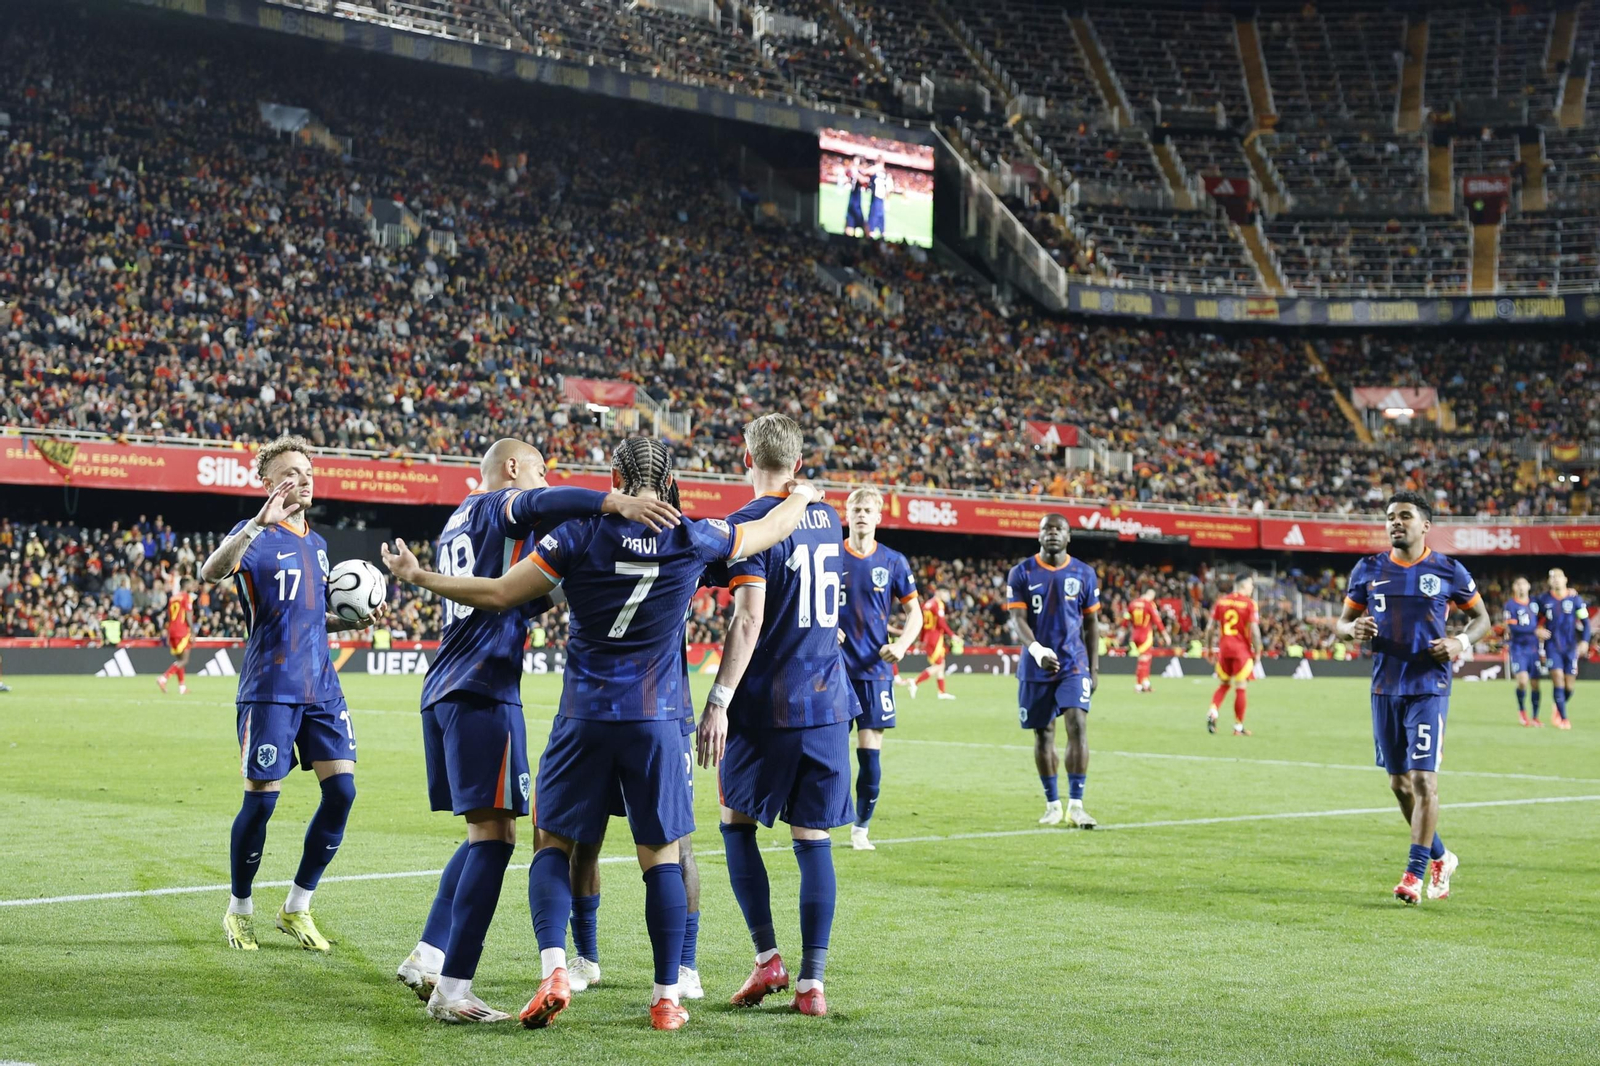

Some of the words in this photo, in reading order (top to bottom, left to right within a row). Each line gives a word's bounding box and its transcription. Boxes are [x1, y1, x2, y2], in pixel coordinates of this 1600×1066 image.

[93, 451, 166, 467] ESPAÑOLA
[73, 465, 128, 478] FÚTBOL
[312, 466, 373, 481] ELECCIÓN
[376, 468, 439, 484] ESPAÑOLA
[341, 480, 357, 491] DE
[360, 479, 408, 494] FÚTBOL
[796, 510, 832, 530] YLOR
[273, 569, 302, 601] 17
[785, 543, 840, 629] 16
[607, 561, 660, 639] 7
[1031, 594, 1043, 615] 9
[1223, 608, 1240, 636] 2
[367, 651, 430, 675] UEFA
[1081, 676, 1092, 698] 9
[879, 690, 893, 713] 6
[1415, 723, 1432, 752] 5
